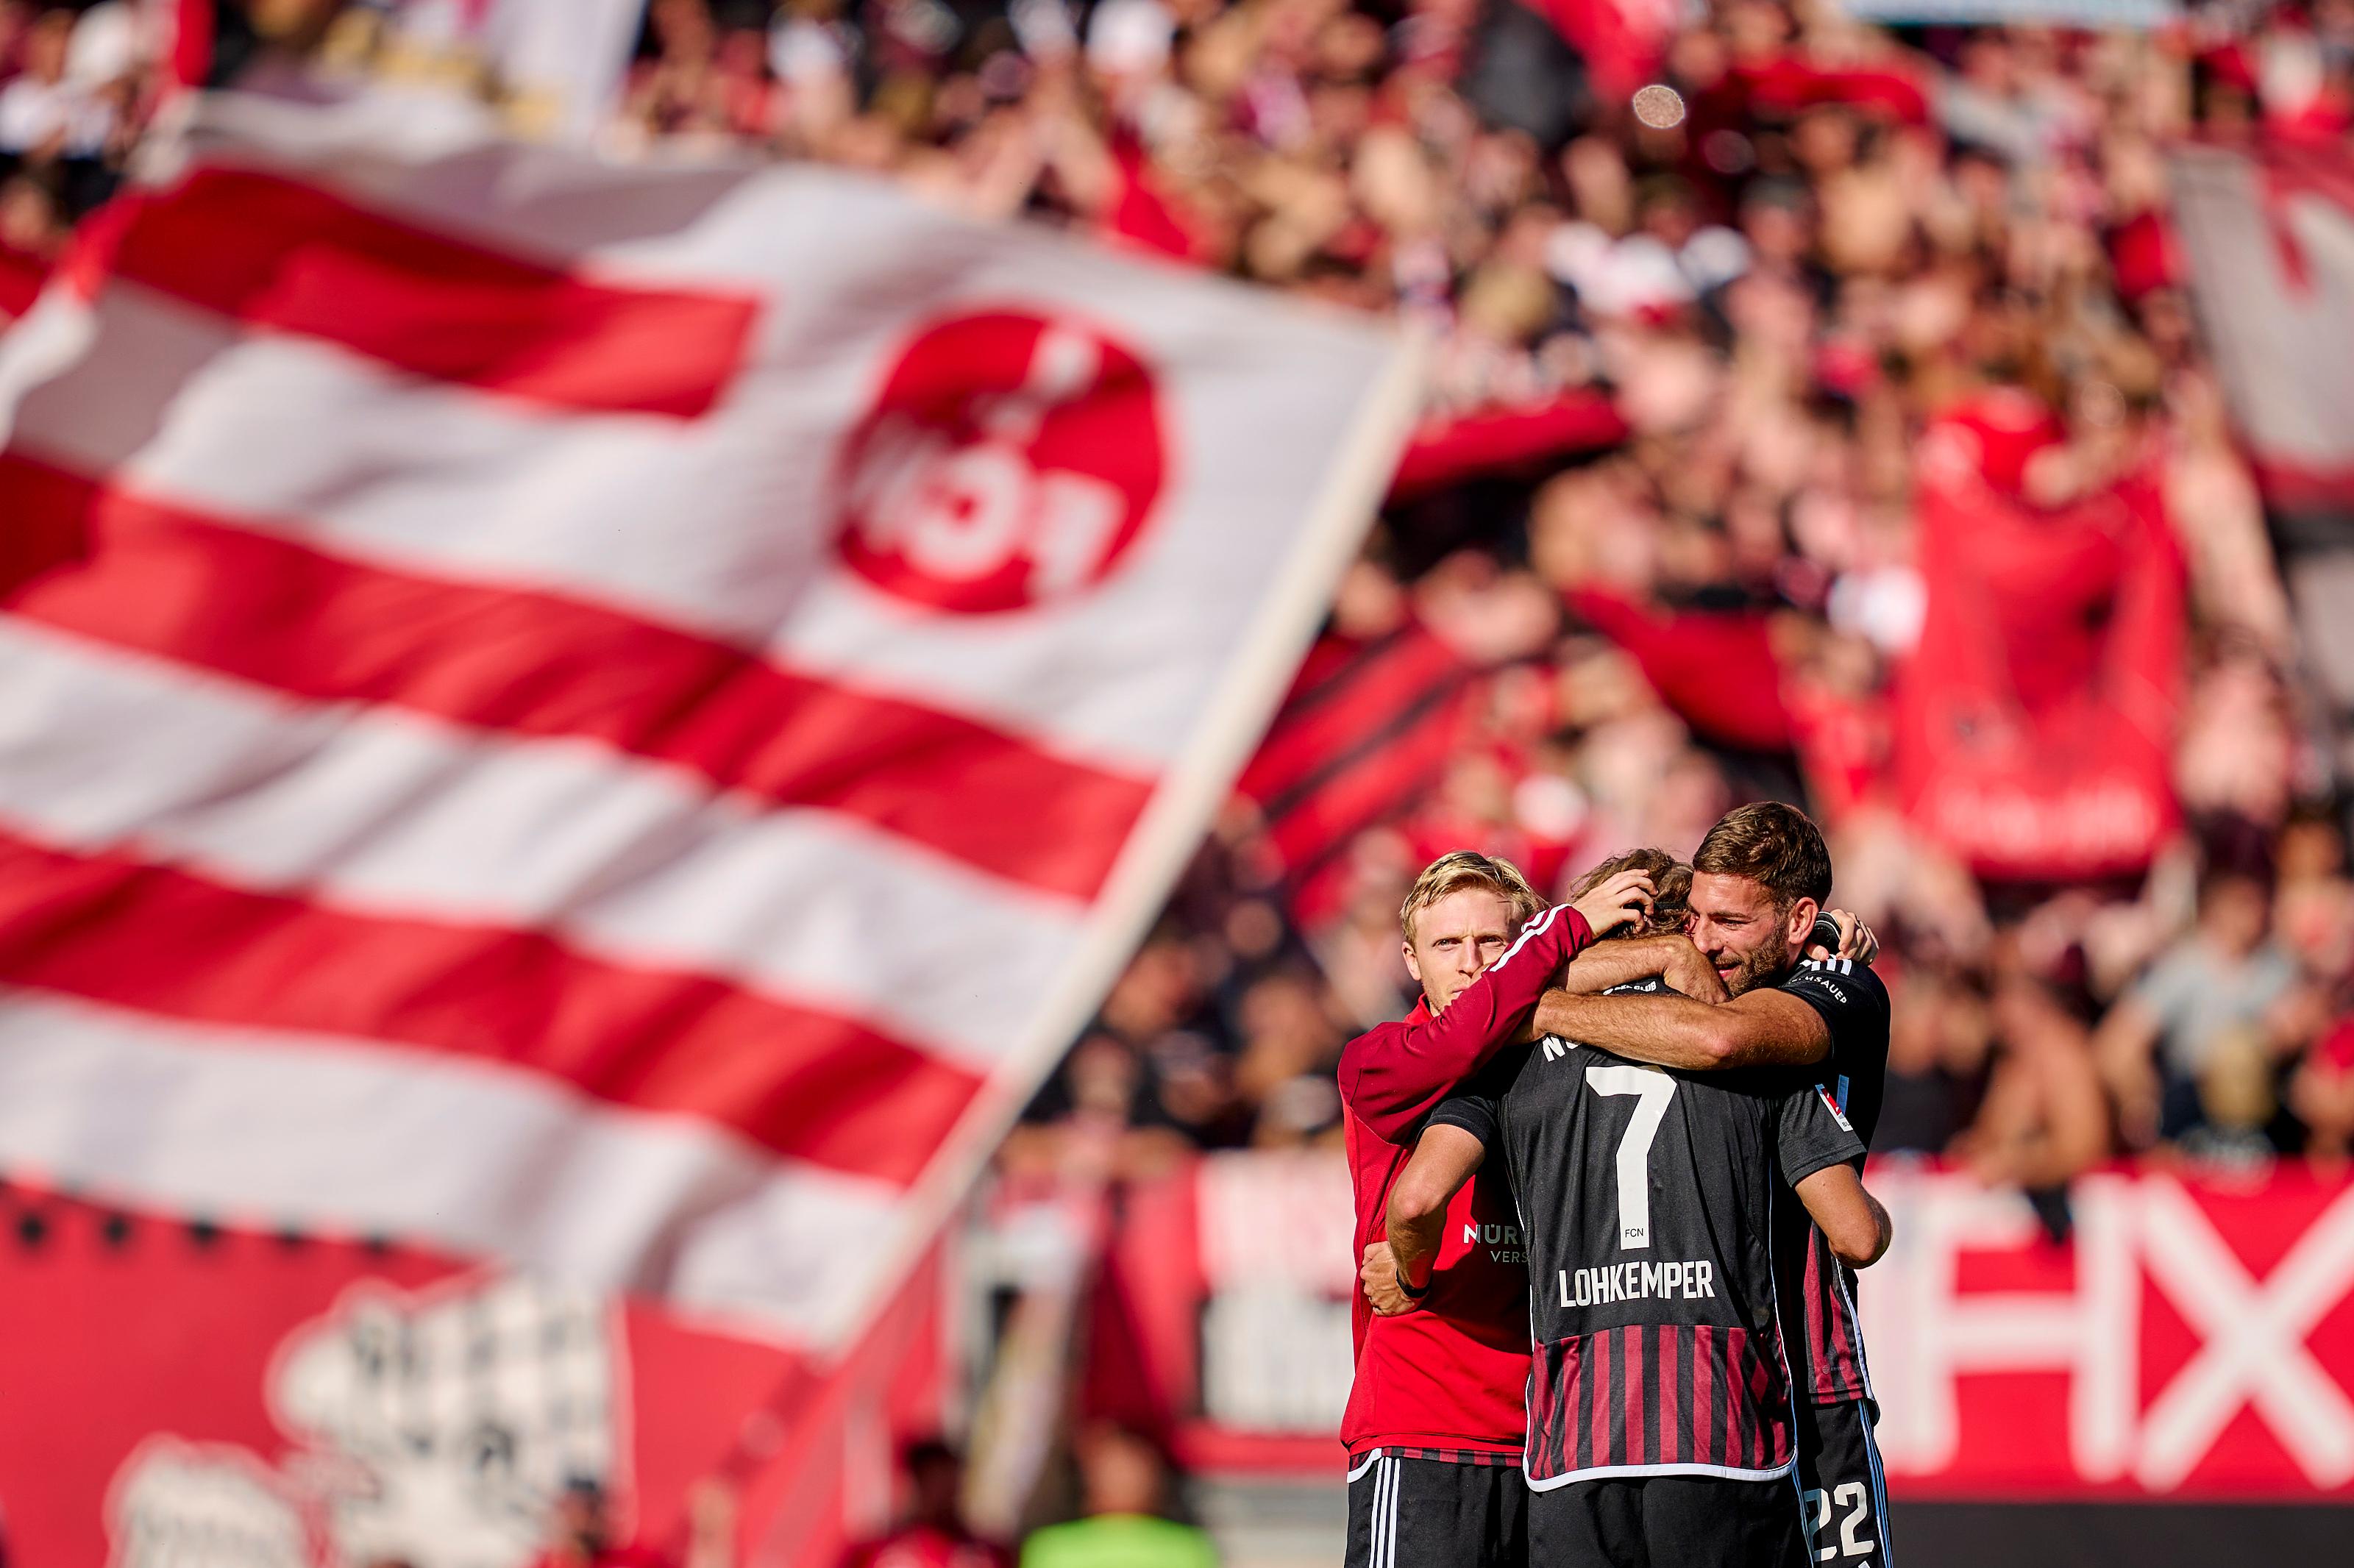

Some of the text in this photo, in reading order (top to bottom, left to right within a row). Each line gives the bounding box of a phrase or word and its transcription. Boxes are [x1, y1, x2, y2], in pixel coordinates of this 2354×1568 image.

[1586, 1065, 1677, 1250] 7
[1463, 1224, 1526, 1244] NÜR
[1625, 1228, 1643, 1238] FCN
[1559, 1260, 1715, 1308] LOHKEMPER
[1803, 1481, 1875, 1562] 22
